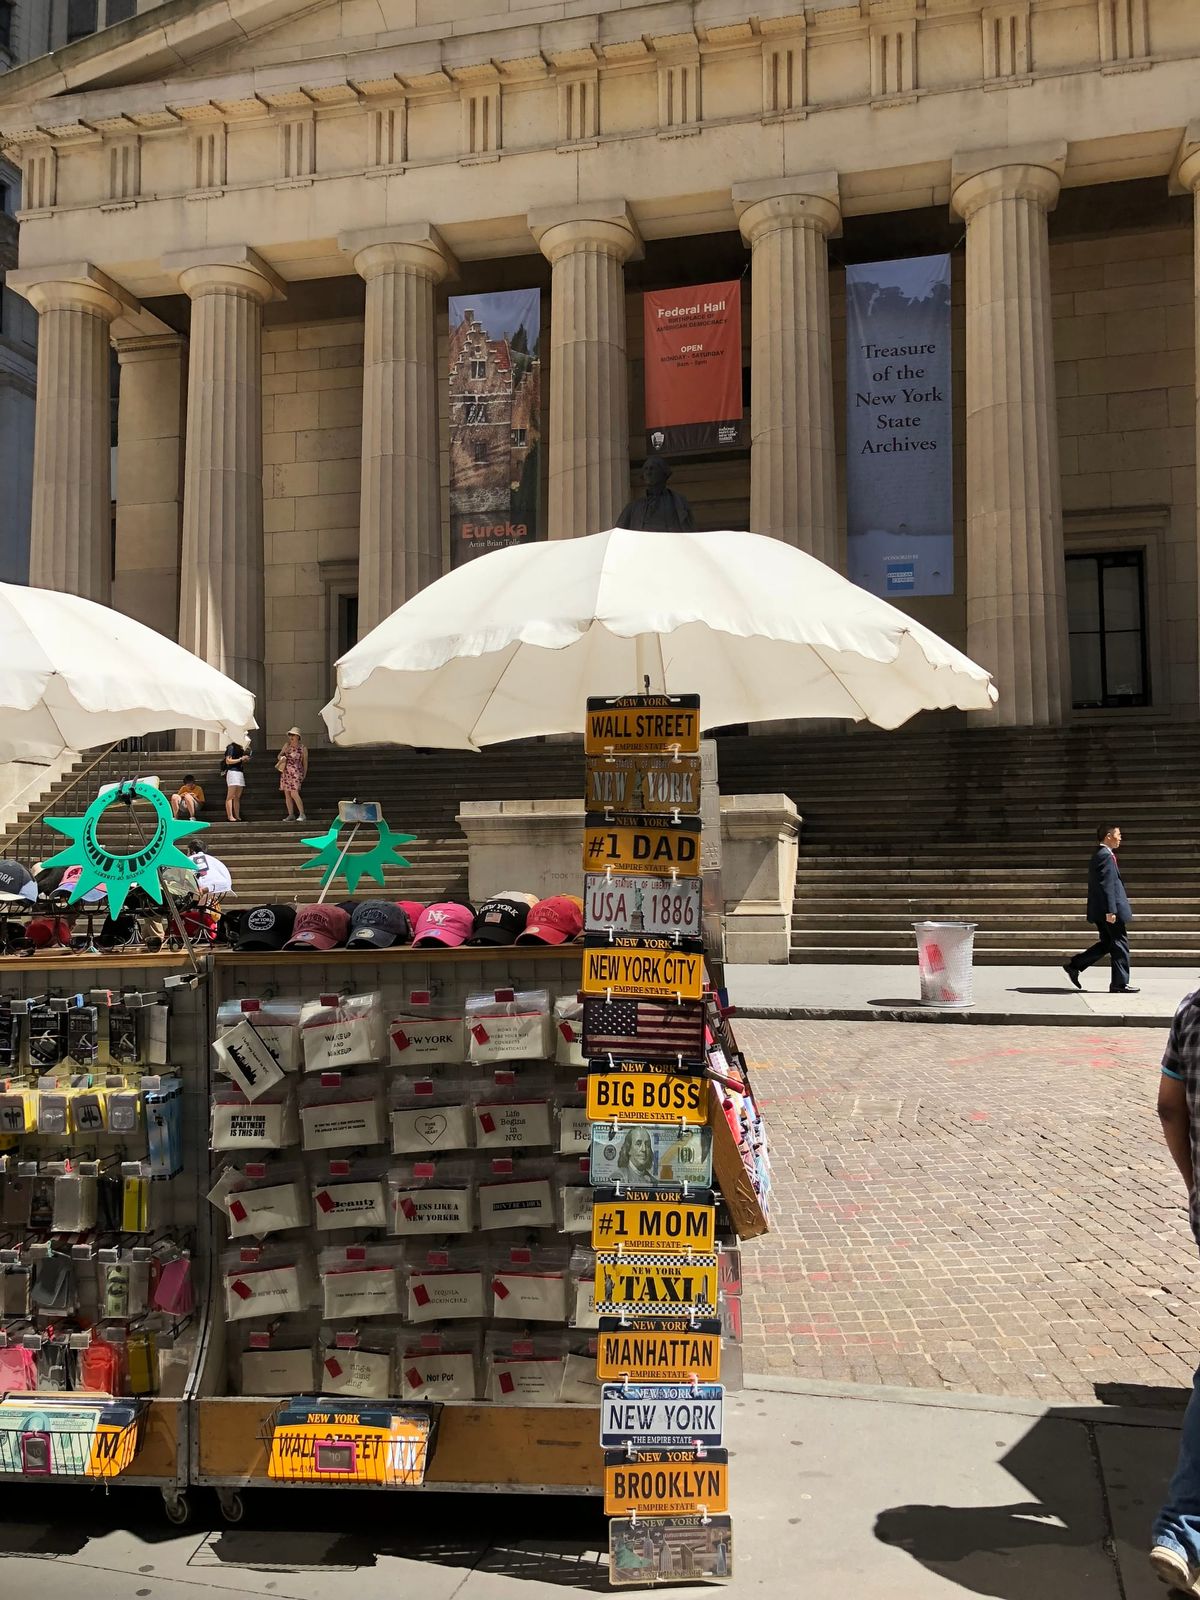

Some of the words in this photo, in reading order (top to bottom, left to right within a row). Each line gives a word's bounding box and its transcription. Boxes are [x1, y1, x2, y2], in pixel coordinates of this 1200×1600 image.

[658, 304, 700, 318] Federal
[704, 301, 725, 312] Hall
[656, 324, 687, 332] AMERICAN
[689, 319, 727, 328] DEMOCRACY
[681, 344, 703, 353] OPEN
[861, 343, 936, 359] Treasure
[692, 351, 724, 359] SATURDAY
[872, 365, 893, 382] of
[897, 364, 925, 380] the
[856, 392, 896, 407] New
[901, 386, 944, 403] York
[877, 414, 921, 429] State
[861, 437, 937, 455] Archives
[462, 521, 527, 539] Eureka
[487, 539, 503, 547] Brian
[504, 538, 520, 547] Tolle
[616, 698, 638, 707] NEW
[643, 697, 669, 706] YORK
[592, 715, 632, 738] WALL
[636, 714, 694, 738] STREET
[592, 772, 628, 801] NEW
[647, 772, 693, 803] YORK
[616, 817, 638, 826] NEW
[643, 818, 669, 827] YORK
[589, 834, 621, 858] #1
[633, 835, 696, 861] DAD
[614, 863, 643, 871] EMPIRE
[644, 864, 668, 872] STATE
[615, 880, 633, 888] STATUE
[641, 881, 649, 889] OF
[652, 881, 671, 890] LIBERTY
[480, 904, 495, 914] NEW
[496, 903, 518, 917] YORK
[592, 892, 627, 922] USA
[652, 894, 694, 925] 1886
[426, 910, 450, 926] NY
[615, 937, 639, 947] NEW
[643, 939, 672, 949] YORK
[589, 954, 621, 981] NEW
[622, 956, 661, 983] YORK
[664, 958, 696, 985] CITY
[613, 985, 643, 993] EMPIRE
[645, 986, 670, 995] STATE
[408, 1036, 423, 1044] EW
[425, 1035, 453, 1044] YORK
[621, 1063, 644, 1072] NEW
[648, 1063, 676, 1073] YORK
[597, 1081, 635, 1106] BIG
[642, 1082, 700, 1109] BOSS
[618, 1111, 648, 1119] EMPIRE
[650, 1112, 675, 1120] STATE
[501, 1118, 526, 1126] Begins
[505, 1133, 522, 1141] NYC
[626, 1191, 649, 1200] NEW
[655, 1192, 681, 1201] YORK
[453, 1203, 459, 1211] A
[599, 1210, 628, 1235] #1
[639, 1210, 708, 1237] MOM
[624, 1240, 654, 1248] EMPIRE
[632, 1267, 652, 1275] NEW
[656, 1267, 682, 1275] YORK
[620, 1276, 694, 1302] TAXI
[633, 1321, 656, 1330] NEW
[661, 1321, 688, 1331] YORK
[605, 1338, 713, 1367] MANHATTAN
[427, 1373, 439, 1382] Not
[442, 1373, 454, 1382] Pot
[630, 1370, 660, 1378] EMPIRE
[662, 1370, 688, 1378] STATE
[635, 1389, 658, 1399] NEW
[663, 1389, 693, 1399] YORK
[307, 1413, 331, 1424] NEW
[334, 1414, 361, 1425] YORK
[609, 1405, 656, 1430] NEW
[665, 1405, 716, 1430] YORK
[278, 1433, 315, 1458] WALL
[632, 1436, 646, 1444] THE
[647, 1436, 670, 1444] EMPIRE
[672, 1436, 692, 1444] STATE
[638, 1453, 662, 1462] NEW
[666, 1451, 695, 1461] YORK
[614, 1470, 720, 1499] BROOKLYN
[637, 1503, 668, 1511] EMPIRE
[670, 1502, 695, 1510] STATE
[671, 1518, 700, 1527] YORK
